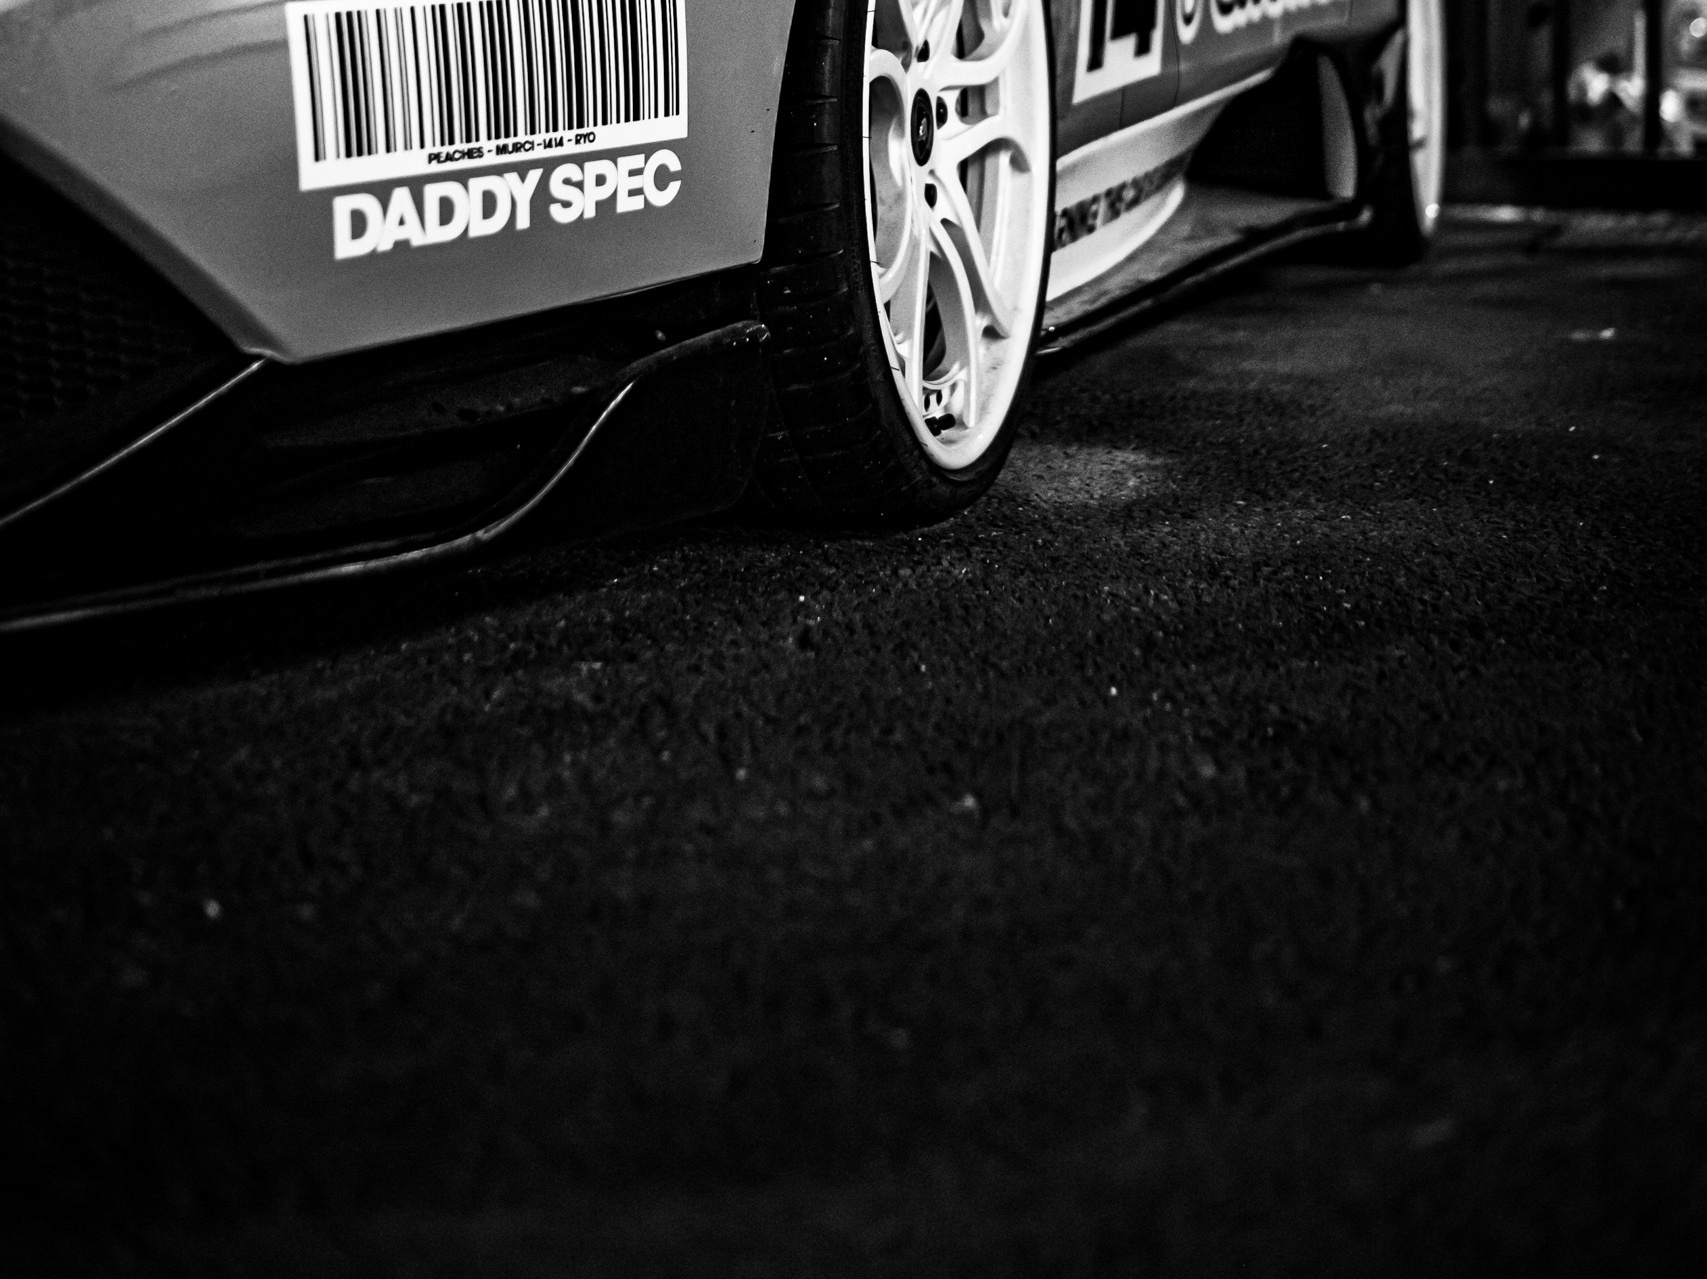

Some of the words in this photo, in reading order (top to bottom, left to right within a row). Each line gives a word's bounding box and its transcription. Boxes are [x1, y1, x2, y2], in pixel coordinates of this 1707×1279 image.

[427, 146, 484, 165] PEACHES
[574, 131, 596, 146] RYO
[332, 167, 544, 261] DADDY
[549, 148, 682, 225] SPEC
